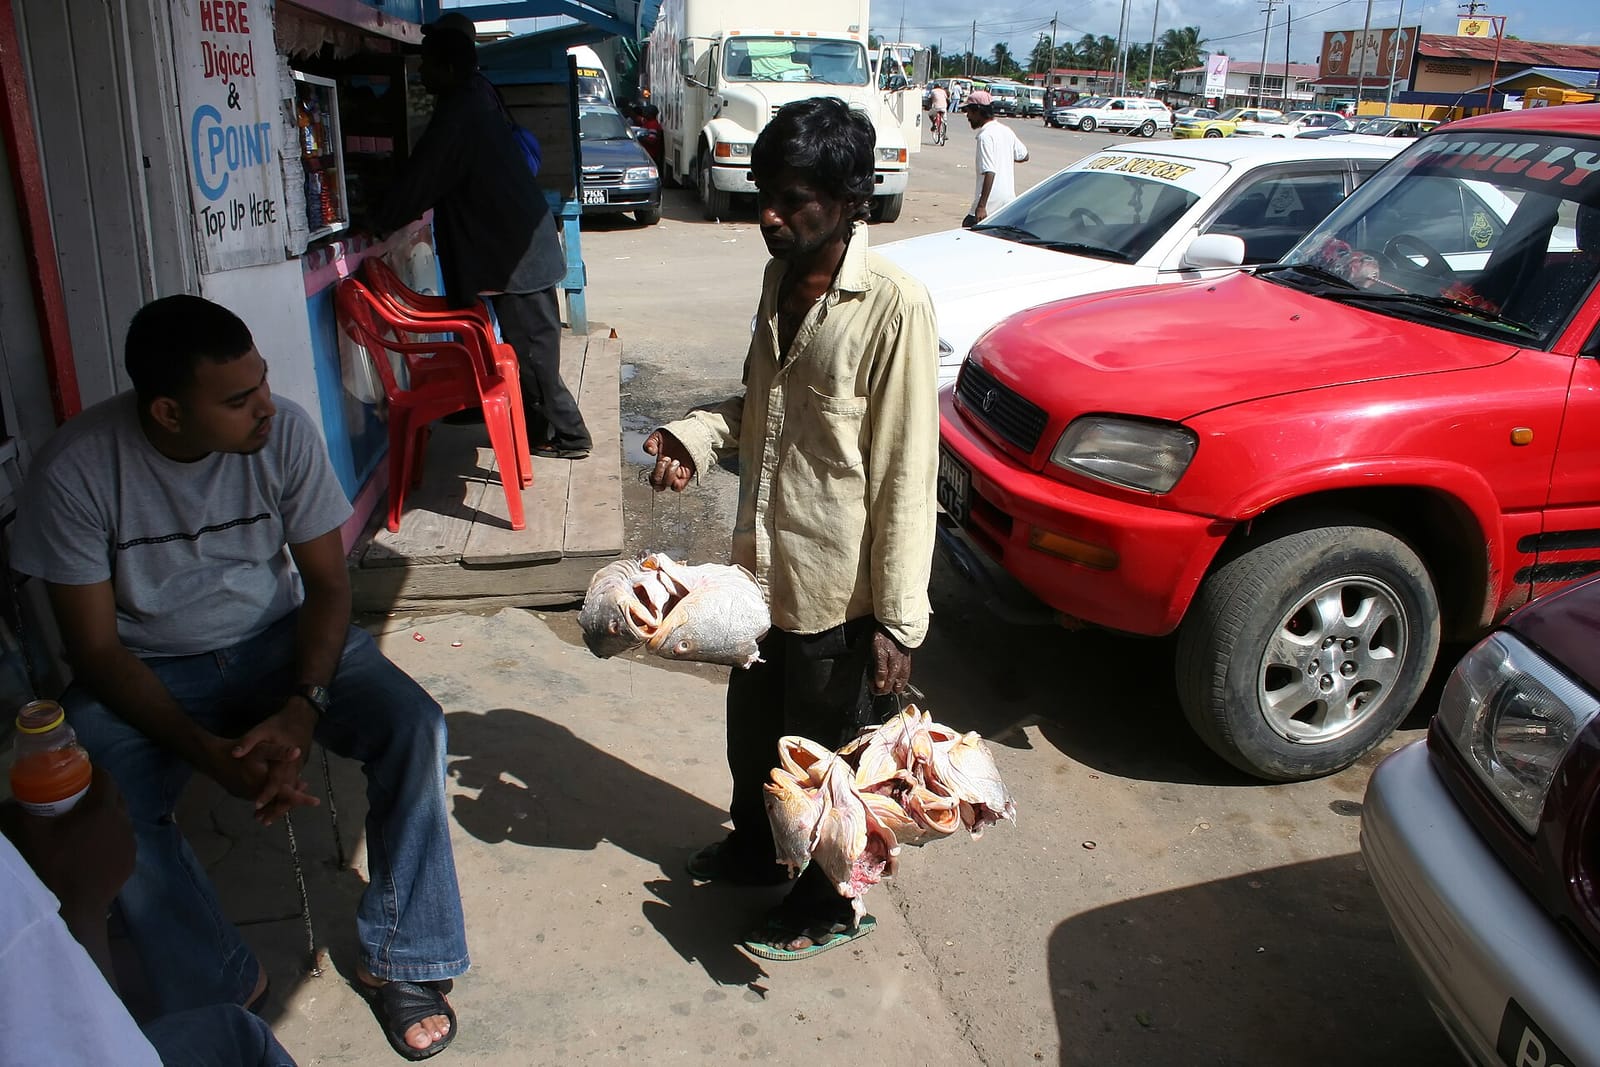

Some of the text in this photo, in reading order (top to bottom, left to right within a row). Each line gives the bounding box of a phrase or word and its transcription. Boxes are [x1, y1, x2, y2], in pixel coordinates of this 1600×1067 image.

[201, 0, 250, 34] HERE
[201, 40, 256, 85] Digicel
[228, 82, 241, 110] &
[1115, 157, 1196, 181] NOTCH
[249, 192, 277, 227] HERE
[583, 189, 604, 198] PKK
[940, 478, 963, 520] 615
